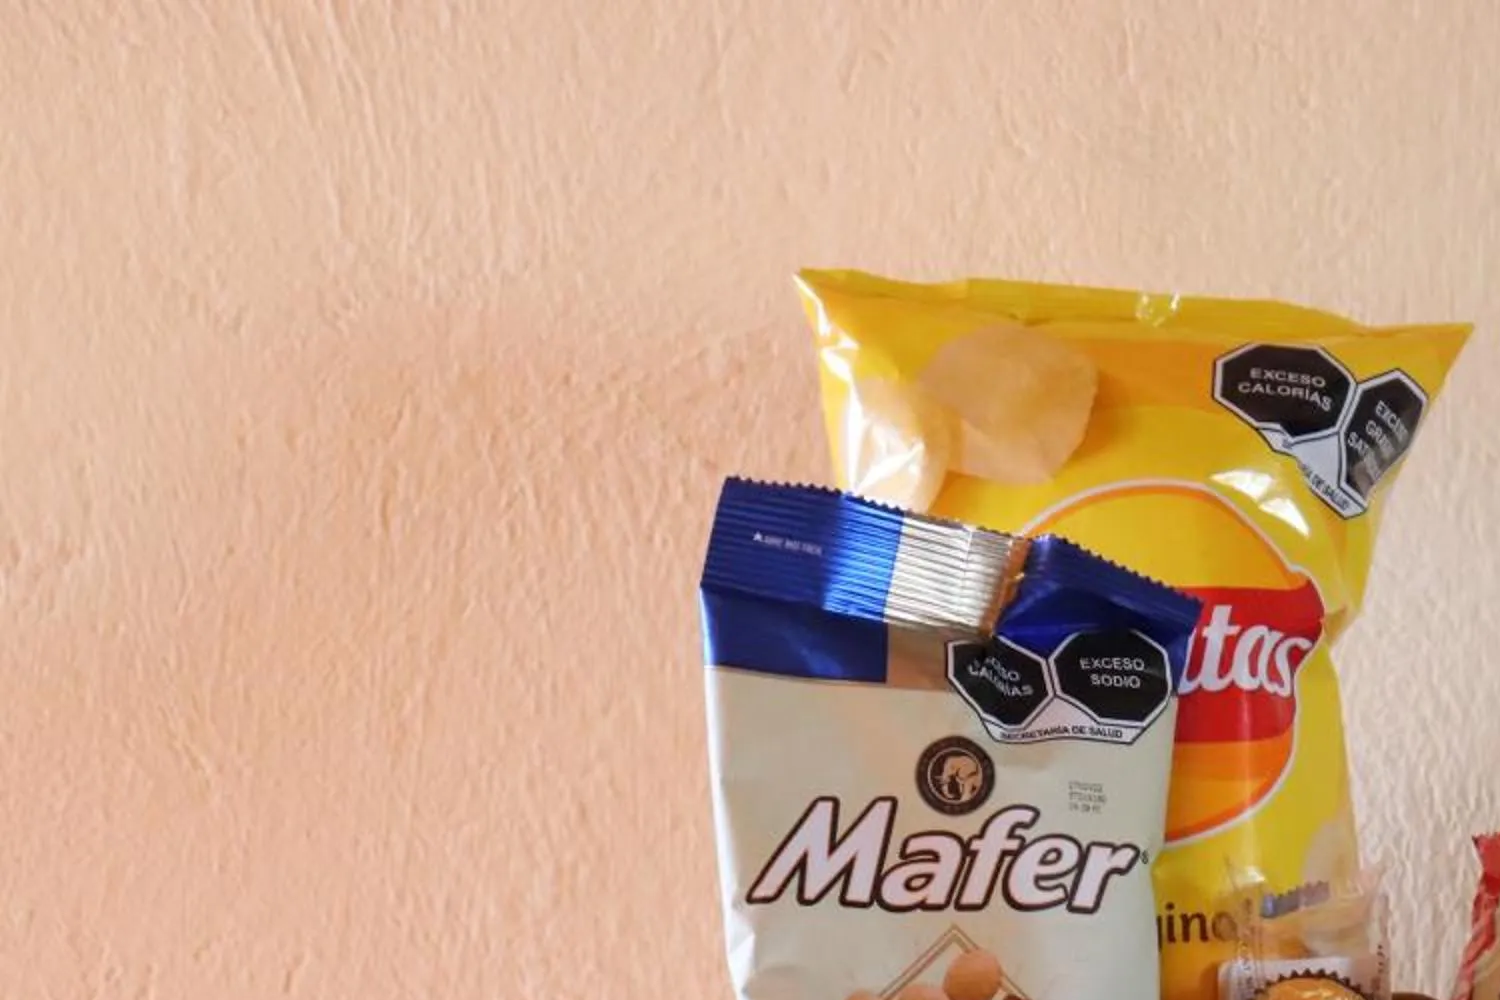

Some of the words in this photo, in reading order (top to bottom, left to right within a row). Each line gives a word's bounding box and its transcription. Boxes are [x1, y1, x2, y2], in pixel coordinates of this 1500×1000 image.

[1250, 366, 1327, 388] EXCESO
[1237, 381, 1333, 413] CALORÍAS
[1079, 656, 1146, 673] EXCESO
[1090, 673, 1142, 689] SODIO
[1071, 725, 1086, 736] DE
[1089, 726, 1123, 739] SALUD
[745, 795, 1141, 914] Mafer
